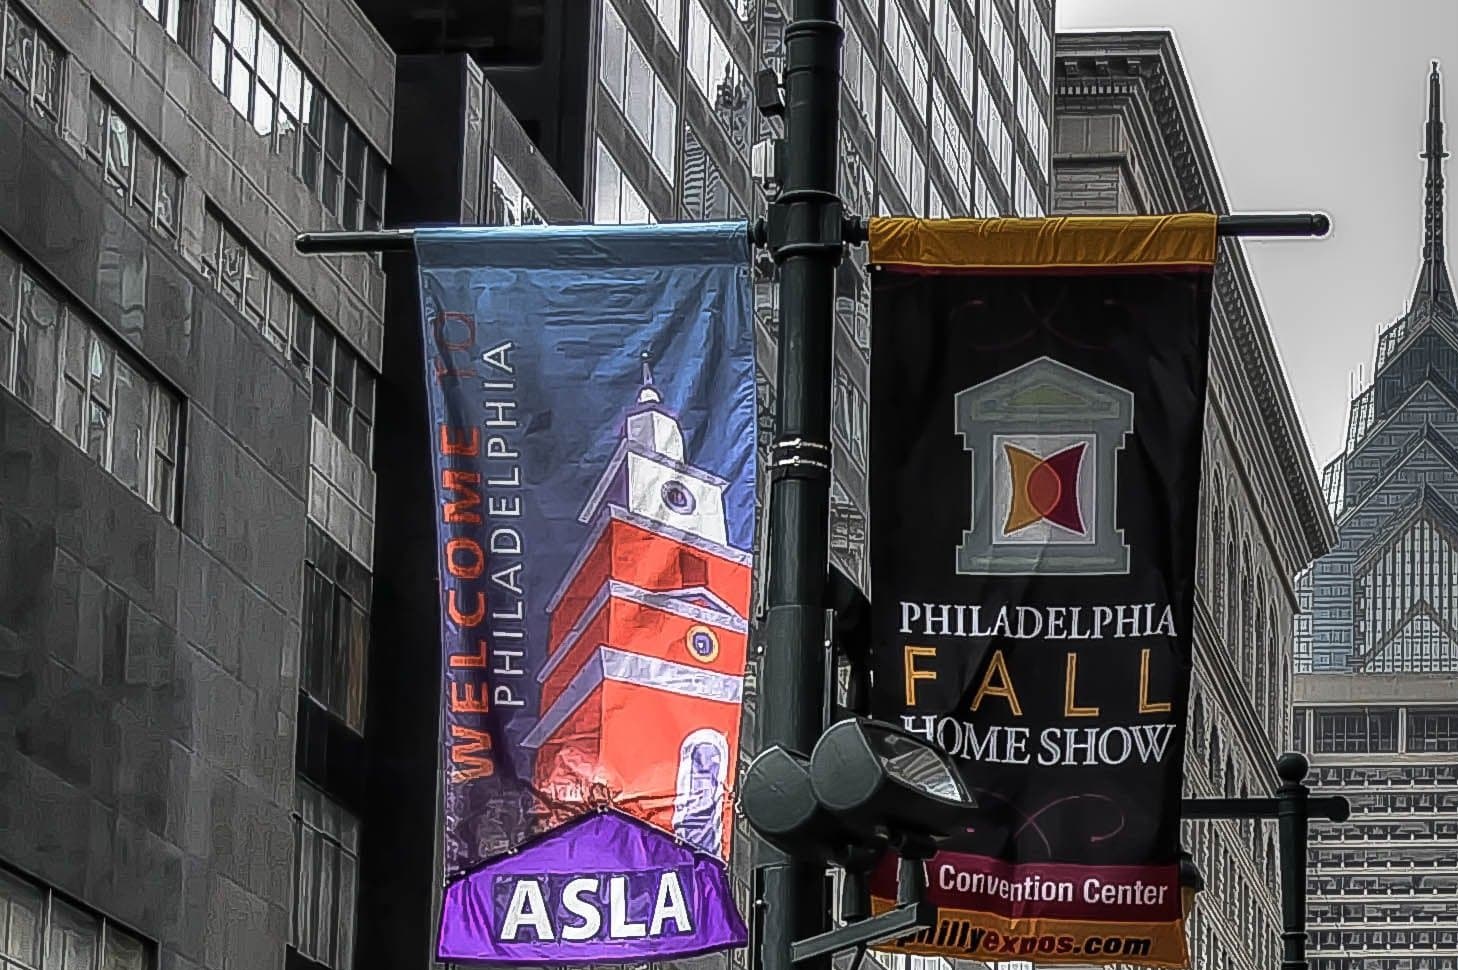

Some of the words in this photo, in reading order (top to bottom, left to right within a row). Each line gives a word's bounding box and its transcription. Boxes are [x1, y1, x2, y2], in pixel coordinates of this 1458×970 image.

[483, 341, 525, 706] PHILADELPHIA
[440, 424, 494, 784] WELCOME
[899, 601, 1178, 640] PHILADELPHIA
[904, 645, 1171, 717] FALL
[900, 714, 1030, 765] HOME
[1037, 724, 1176, 766] SHOW
[500, 871, 693, 940] ASLA
[938, 864, 1073, 902] Convention
[1083, 878, 1168, 905] Center
[897, 919, 1152, 957] hillyexpos.com
